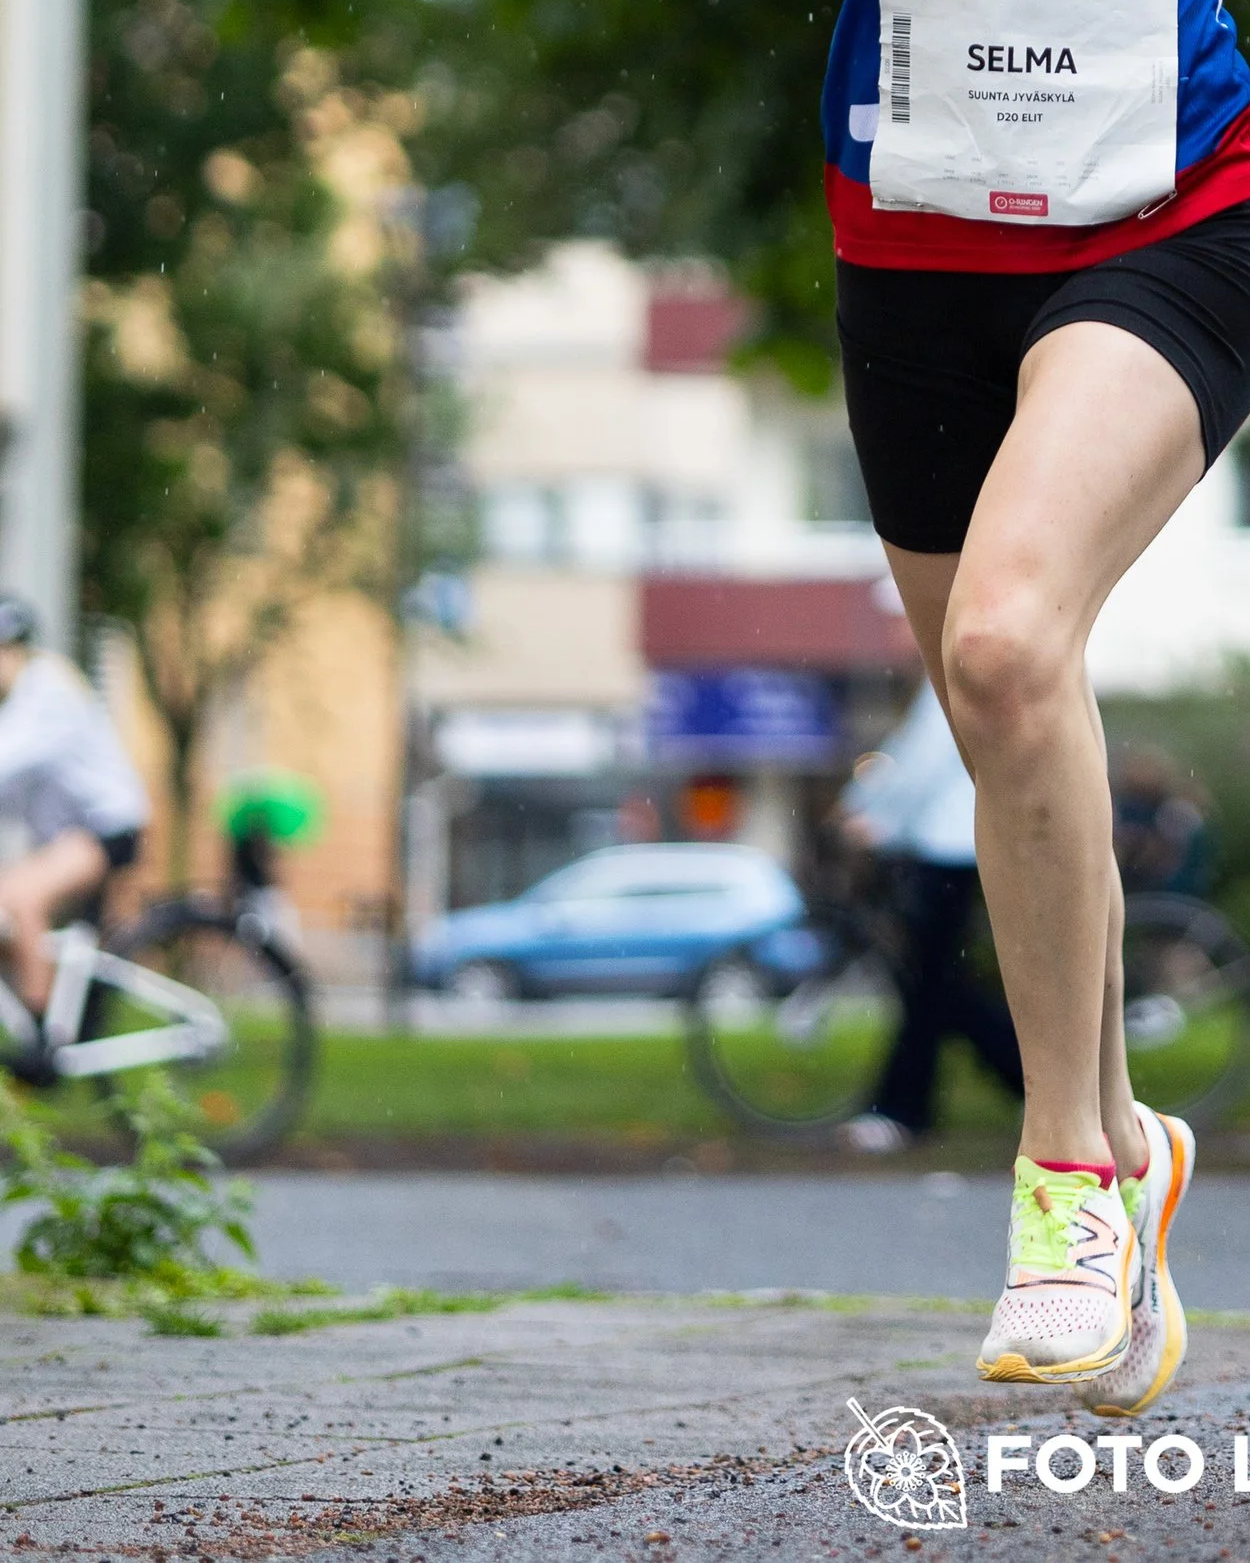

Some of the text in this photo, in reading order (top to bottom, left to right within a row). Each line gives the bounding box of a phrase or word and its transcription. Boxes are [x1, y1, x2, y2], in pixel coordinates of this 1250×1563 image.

[966, 43, 1078, 75] SELMA
[968, 89, 1076, 103] SUUNTA JYVÄSKYLÄ
[996, 112, 1044, 123] D20 ELIT
